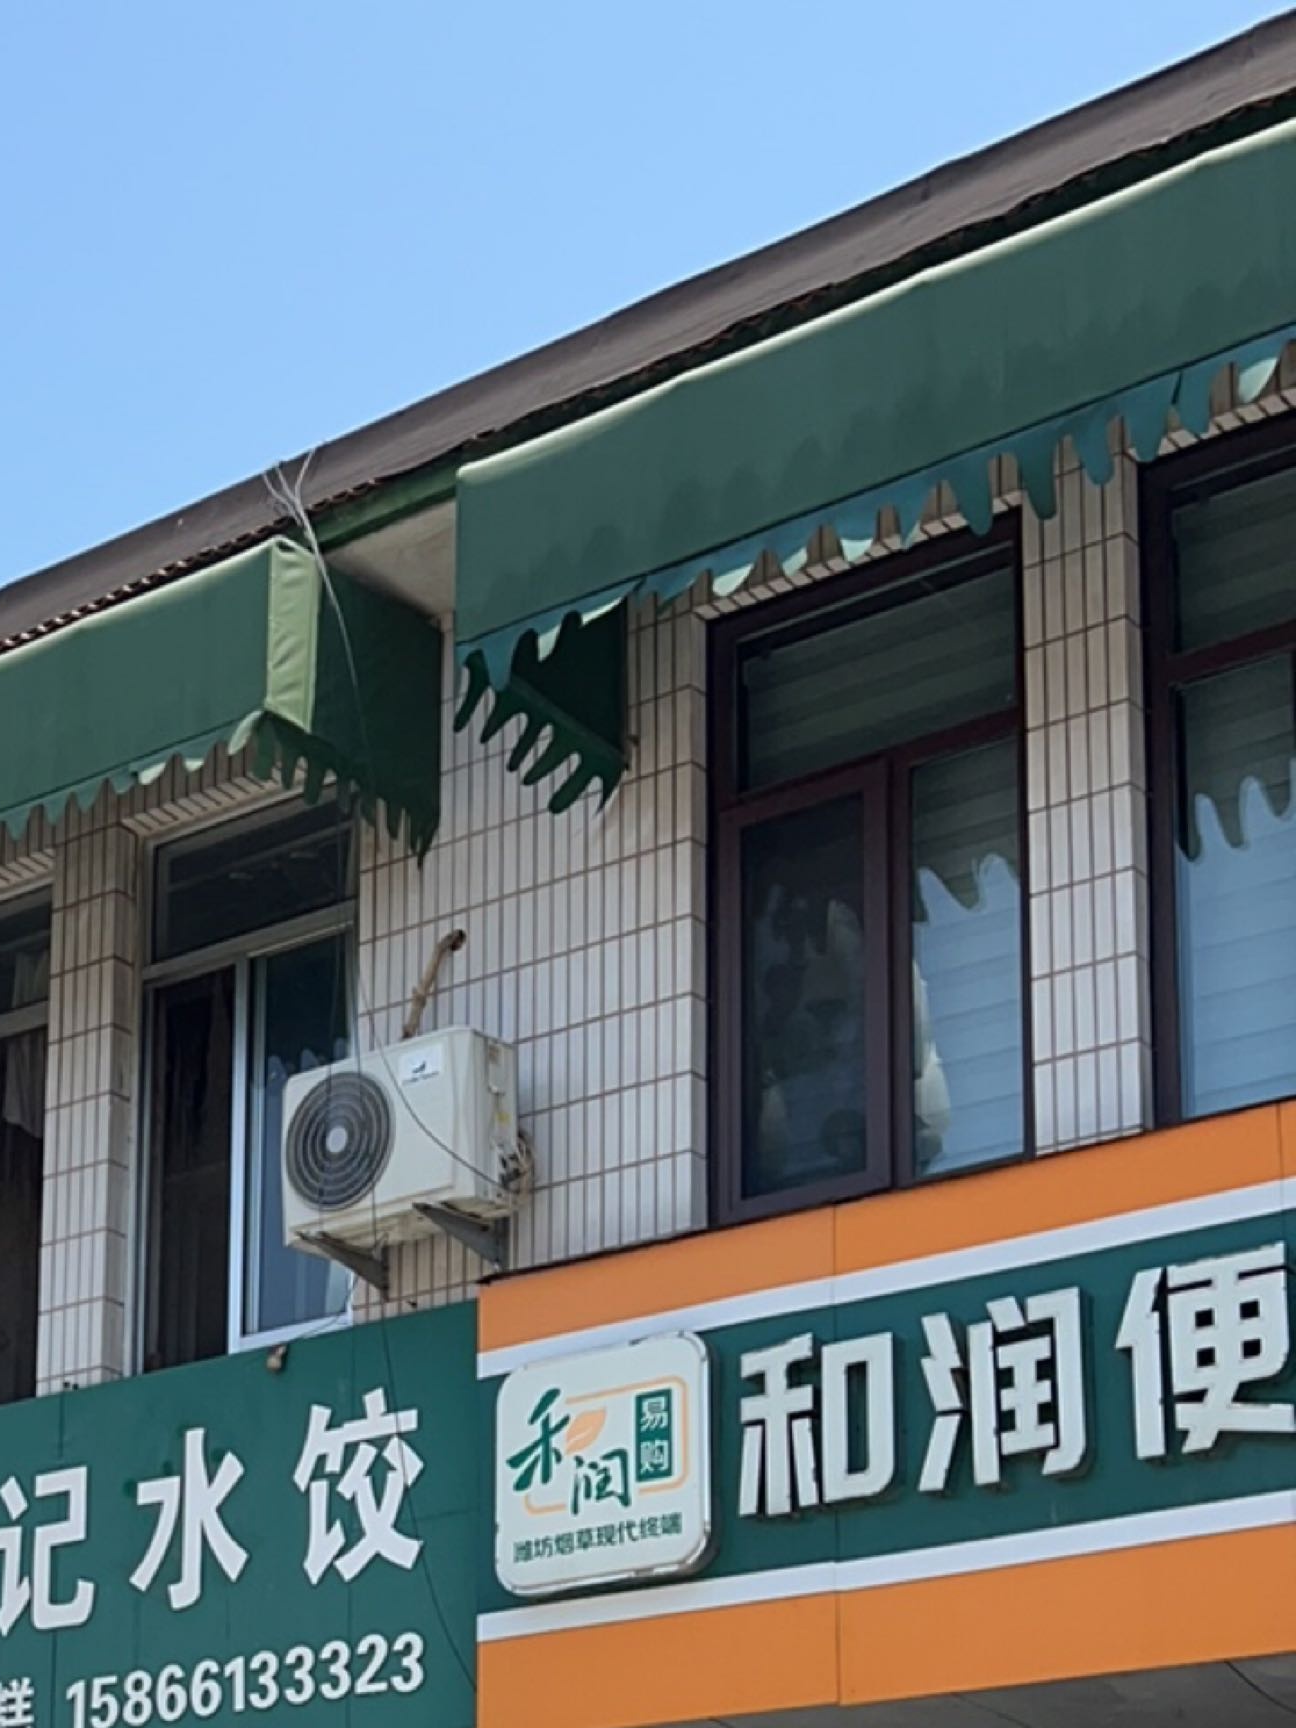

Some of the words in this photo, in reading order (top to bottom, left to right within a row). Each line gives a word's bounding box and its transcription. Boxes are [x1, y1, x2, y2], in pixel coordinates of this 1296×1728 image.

[738, 1240, 1296, 1517] 和润便
[639, 1396, 669, 1474] 易购
[513, 1512, 683, 1563] 潍坊烟草现代终端
